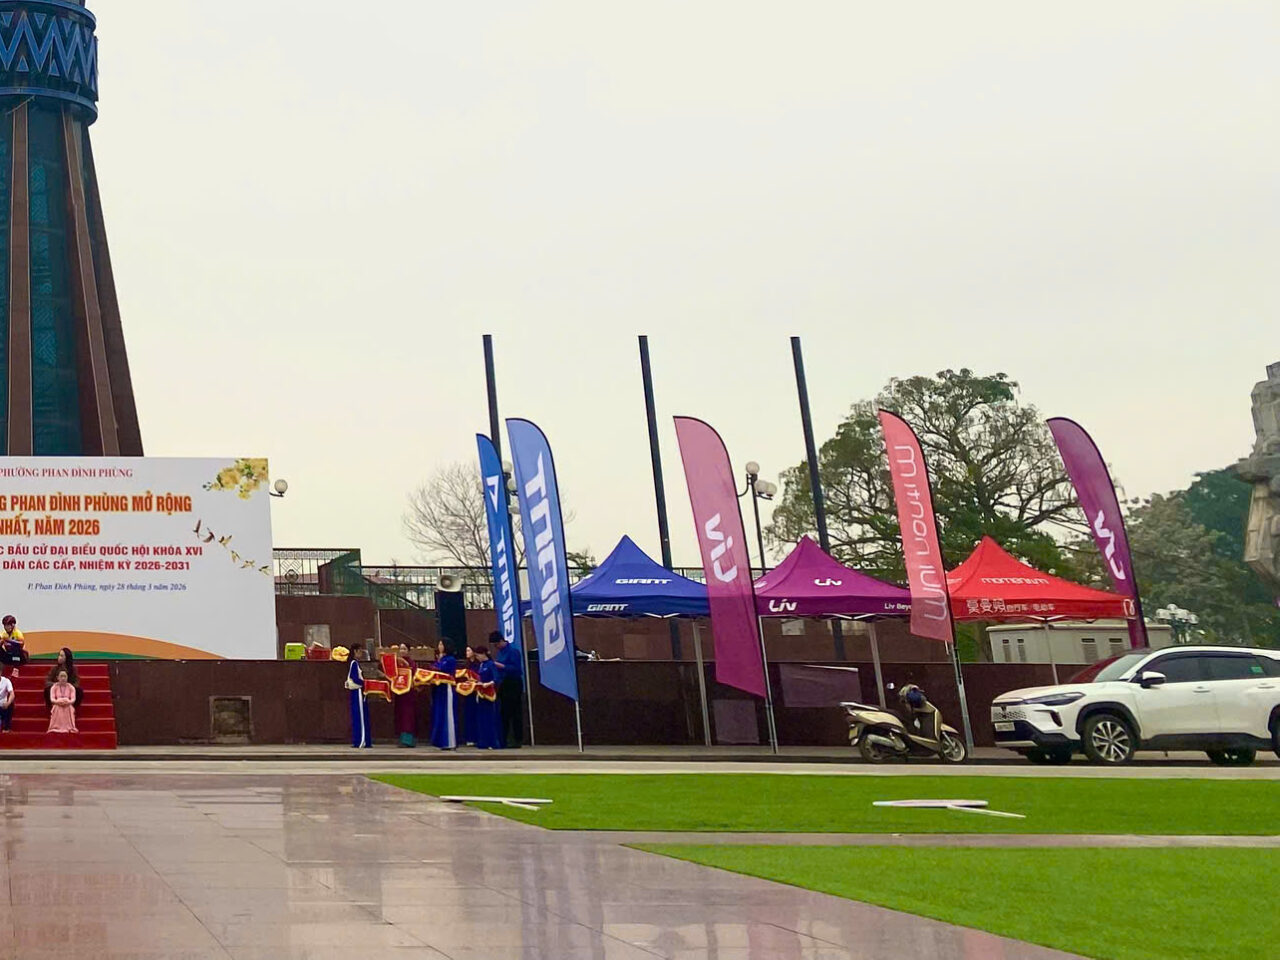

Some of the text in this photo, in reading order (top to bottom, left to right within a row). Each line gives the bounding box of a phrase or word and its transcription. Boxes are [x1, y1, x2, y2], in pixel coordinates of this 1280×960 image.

[42, 468, 70, 478] PHAN
[72, 466, 97, 478] ĐÌNH
[99, 467, 133, 478] PHÙNG
[11, 495, 46, 512] PHAN
[49, 492, 80, 512] ĐÌNH
[84, 492, 128, 512] PHÙNG
[131, 491, 153, 512] MỞ
[156, 492, 192, 515] RỘNG
[35, 515, 65, 535] NĂM
[69, 519, 100, 535] 2026
[8, 543, 29, 555] BẦU
[33, 543, 47, 555] CỬ
[50, 546, 68, 557] ĐẠI
[72, 543, 96, 555] BIỂU
[100, 544, 128, 556] QUỐC
[132, 544, 149, 557] HỘI
[185, 546, 202, 555] XVI
[3, 559, 25, 570] DÂN
[28, 559, 50, 570] CÁC
[53, 558, 76, 571] CẤP,
[79, 559, 114, 572] NHIỆM
[118, 559, 132, 571] KỲ
[134, 561, 190, 571] 2026-2031
[814, 578, 842, 586] Liv
[586, 603, 629, 611] GIANT
[768, 599, 798, 613] Liv
